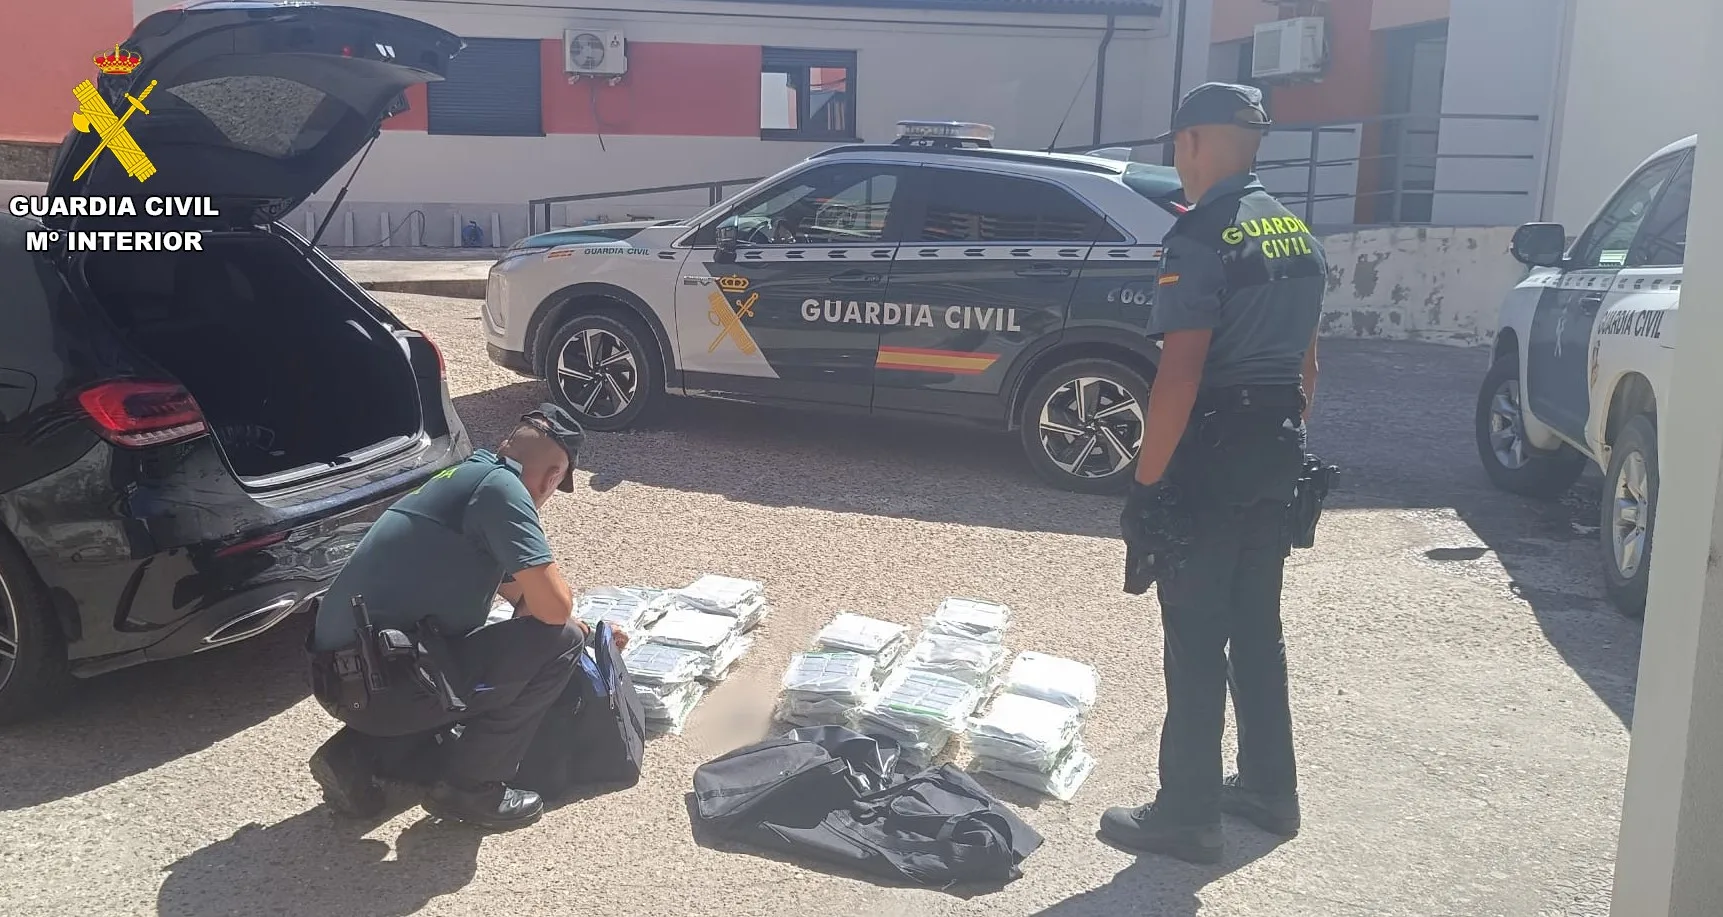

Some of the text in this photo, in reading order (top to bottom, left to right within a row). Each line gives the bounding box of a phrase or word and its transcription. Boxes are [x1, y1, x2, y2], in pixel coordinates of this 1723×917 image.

[584, 247, 650, 256] GUARDIA CIVIL
[1261, 236, 1312, 259] CIVIL
[801, 298, 1021, 332] GUARDIA CIVIL
[1634, 309, 1664, 339] CIVIL
